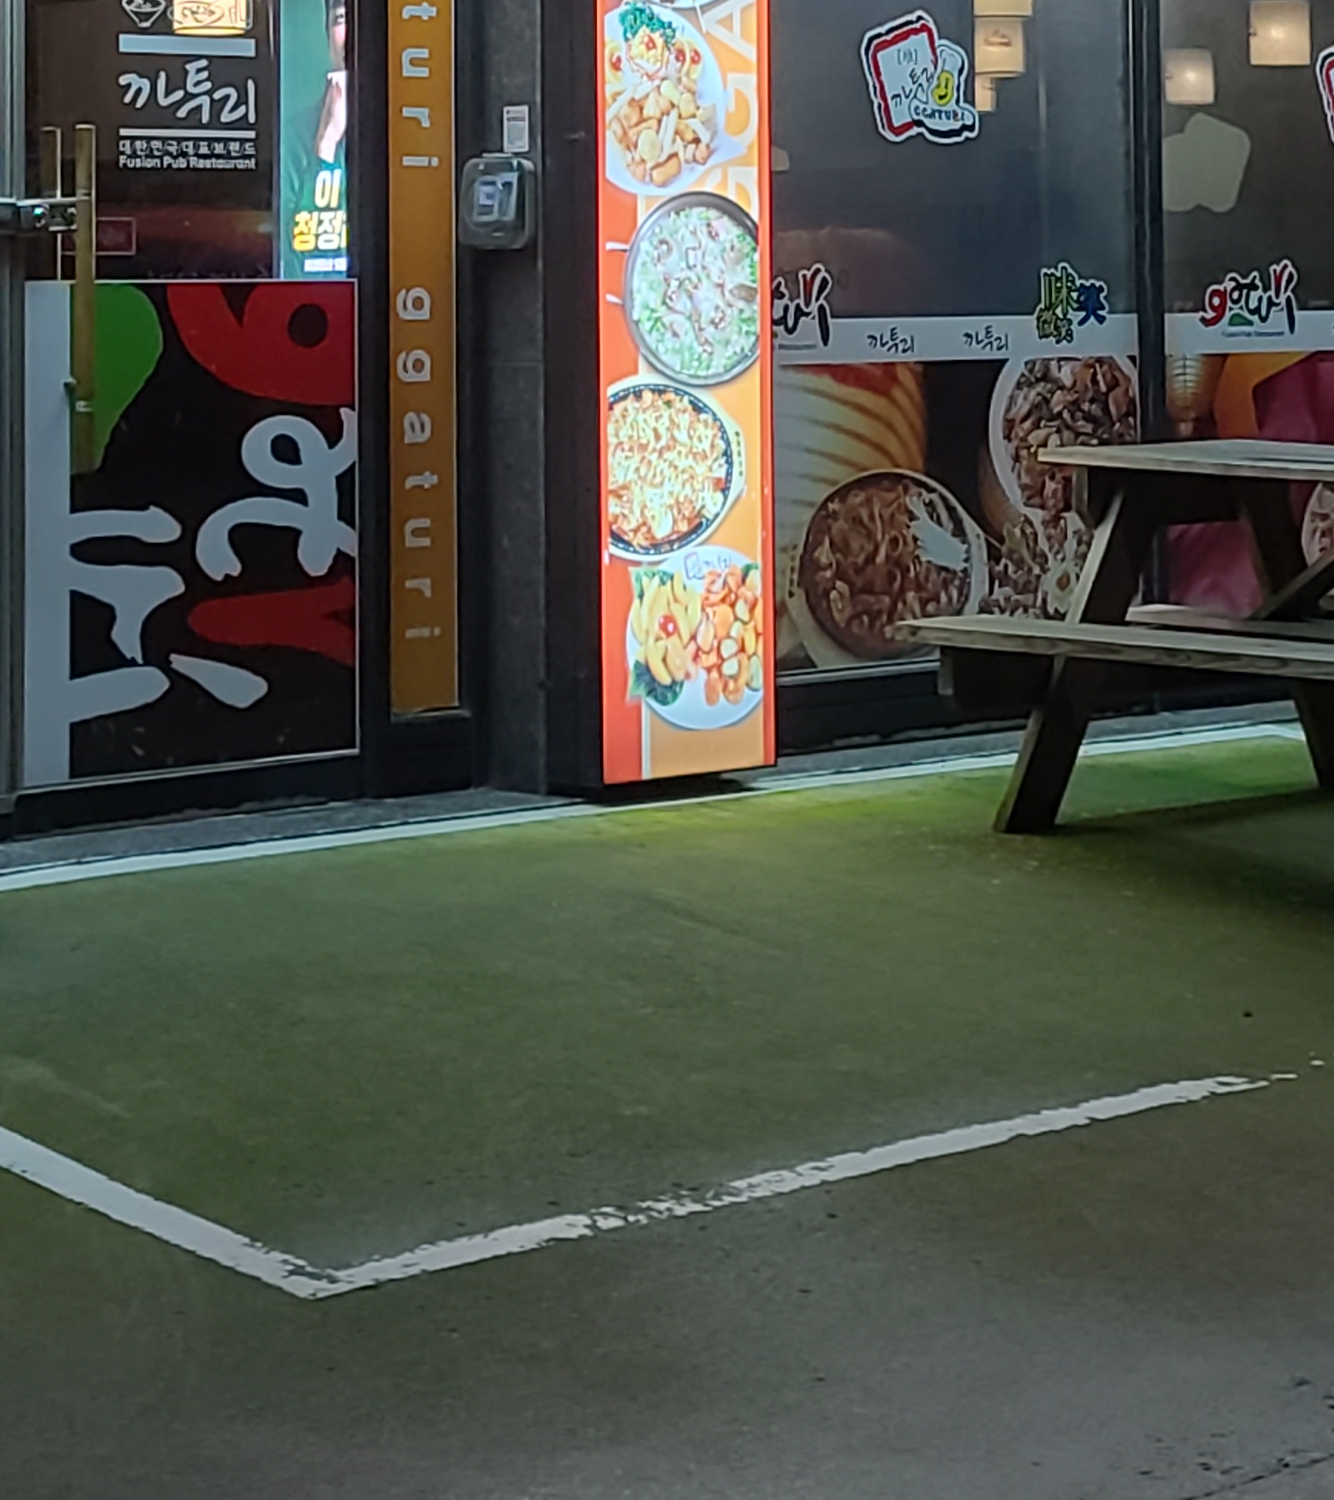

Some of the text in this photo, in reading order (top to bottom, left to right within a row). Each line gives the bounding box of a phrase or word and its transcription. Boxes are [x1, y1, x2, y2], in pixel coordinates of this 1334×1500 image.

[118, 58, 256, 125] 까투리
[118, 155, 256, 170] Fusion Pub Restaurant
[866, 326, 915, 354] 까투리
[963, 325, 1009, 353] 까투리
[396, 286, 441, 639] ggaturi
